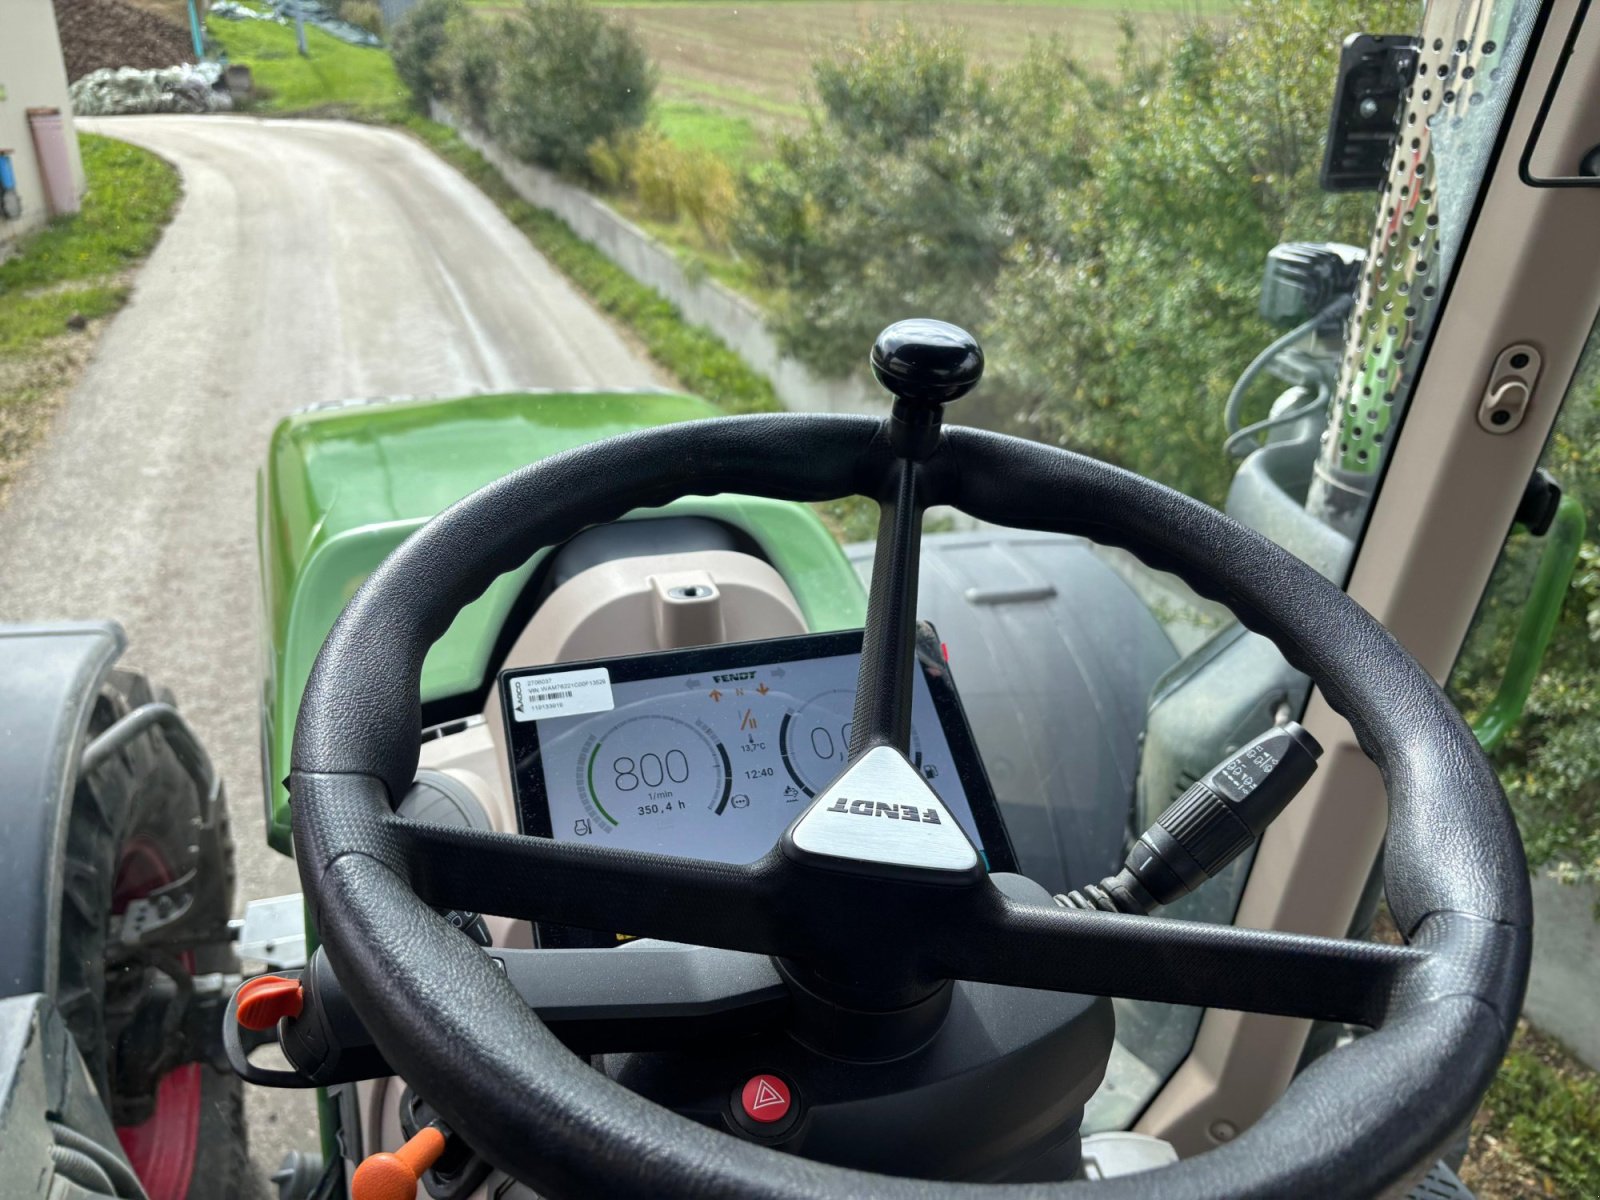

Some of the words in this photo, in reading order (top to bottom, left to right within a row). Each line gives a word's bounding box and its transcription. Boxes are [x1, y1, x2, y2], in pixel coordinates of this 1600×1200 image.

[712, 670, 757, 684] FENDT
[735, 687, 744, 697] N
[613, 749, 689, 792] 800
[745, 767, 774, 780] 12:40
[648, 790, 673, 800] 1/min
[678, 799, 686, 810] h
[826, 797, 942, 825] FENDT
